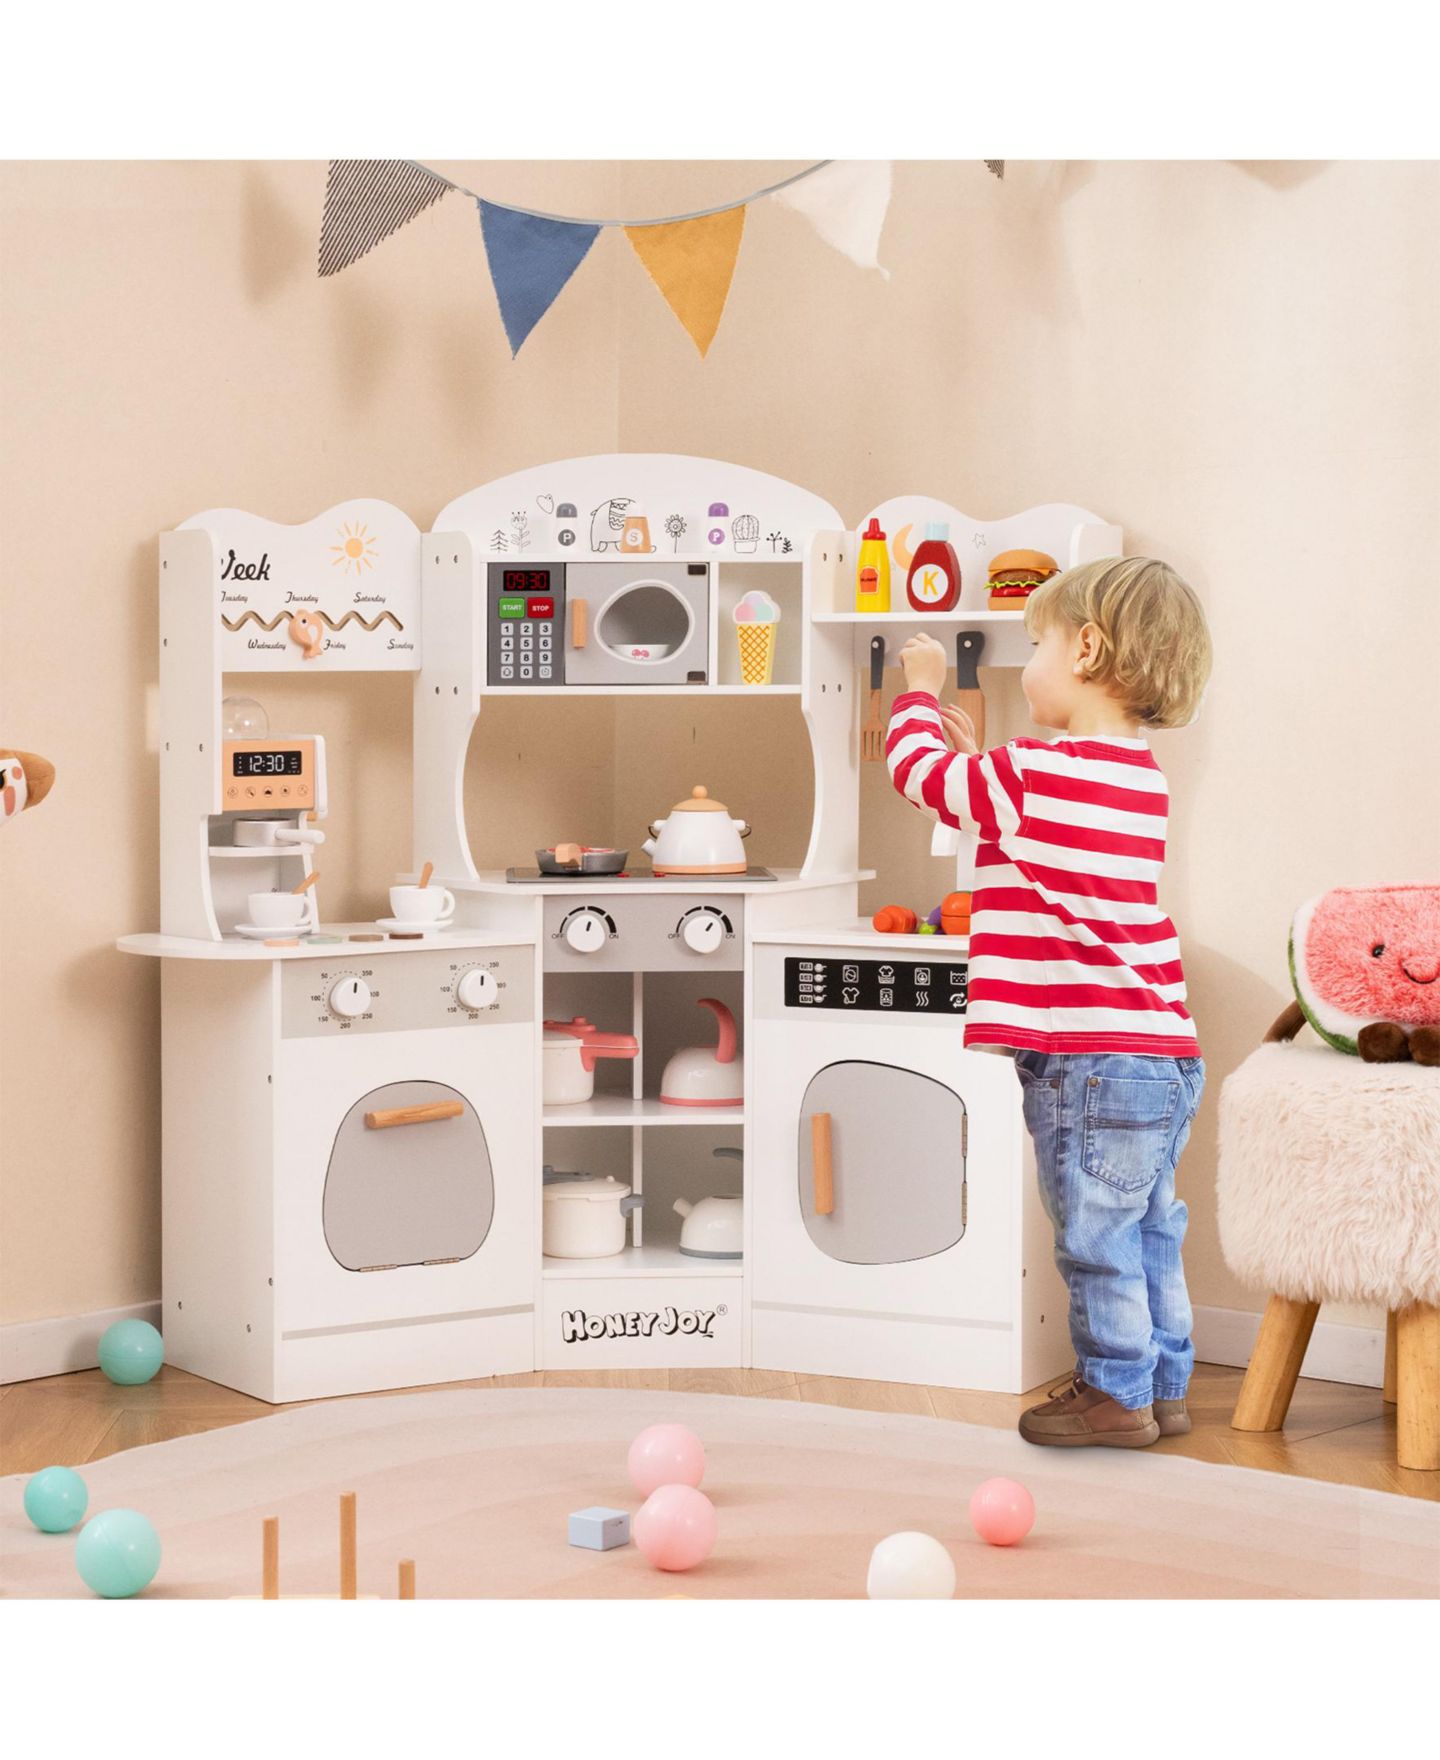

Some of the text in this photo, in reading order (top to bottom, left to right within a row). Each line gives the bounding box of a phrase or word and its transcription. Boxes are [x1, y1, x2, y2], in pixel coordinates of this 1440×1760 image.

[563, 533, 571, 542] P
[630, 532, 639, 543] S
[713, 532, 721, 542] P
[506, 572, 547, 590] 09:30
[923, 570, 939, 596] K
[285, 591, 319, 604] Thursday
[353, 592, 386, 604] Saturday
[532, 604, 550, 612] STOP
[504, 625, 549, 633] 1 2 3
[248, 639, 414, 651] Wednesday Friday Sunday
[504, 639, 549, 647] 4 5 6
[504, 654, 549, 662] 7 8 9
[523, 668, 530, 676] 0
[249, 755, 285, 773] 12:30
